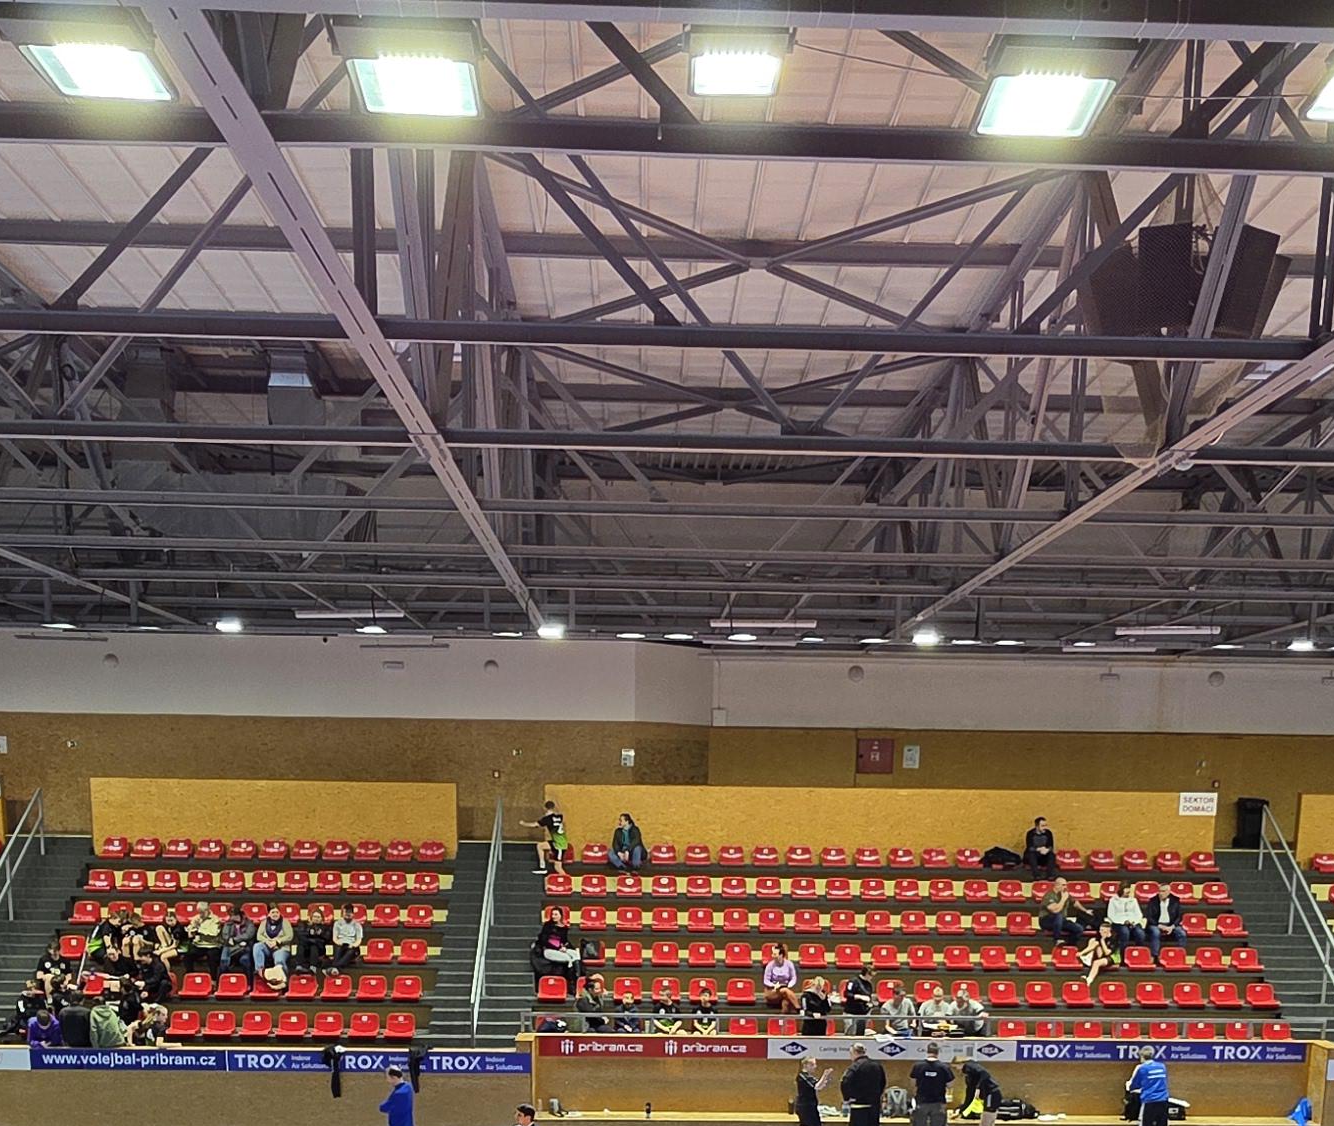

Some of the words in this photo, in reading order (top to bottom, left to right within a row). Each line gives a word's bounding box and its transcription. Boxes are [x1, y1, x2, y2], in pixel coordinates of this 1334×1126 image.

[1020, 1043, 1071, 1059] TROX
[1212, 1045, 1263, 1060] TROX
[42, 1052, 216, 1068] www.volejbal-pribram.cz
[235, 1053, 287, 1069] TROX
[429, 1055, 482, 1071] TROX
